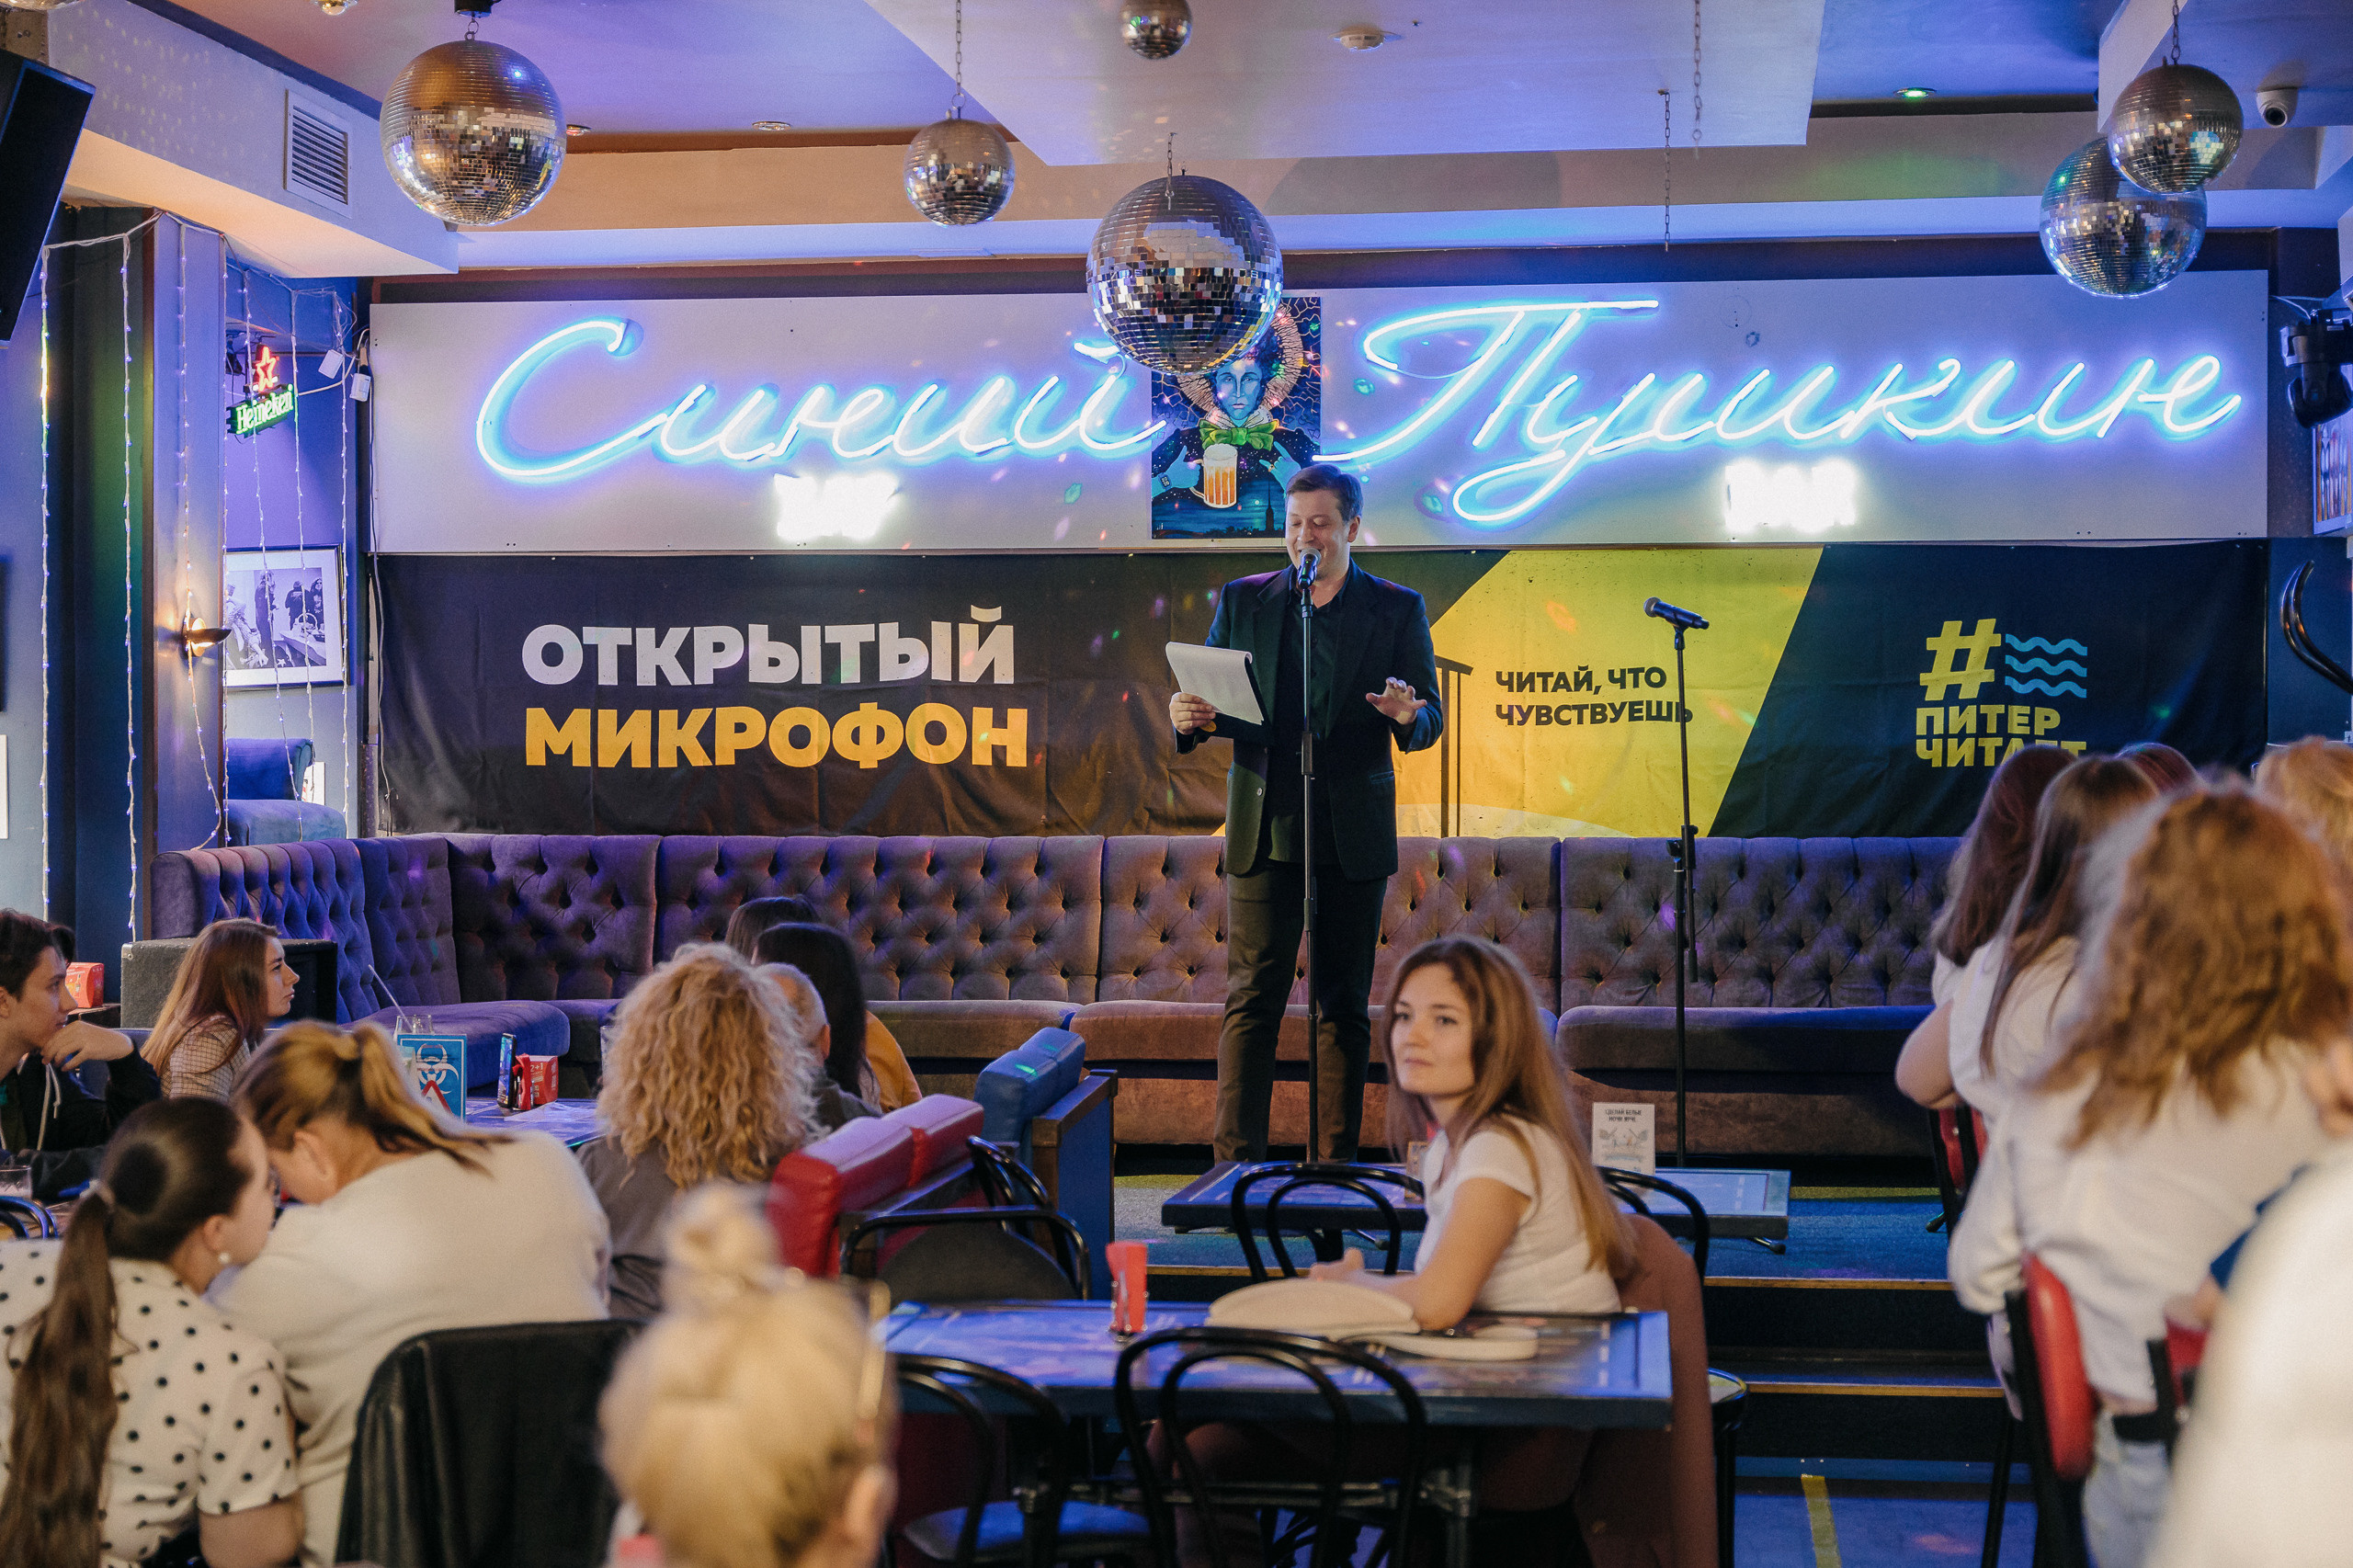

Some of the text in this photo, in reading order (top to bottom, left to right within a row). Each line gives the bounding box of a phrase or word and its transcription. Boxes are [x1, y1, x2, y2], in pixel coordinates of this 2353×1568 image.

[235, 383, 294, 435] Heineken
[473, 299, 2241, 522] Синий Пушкин
[521, 604, 1016, 687] ОТКРЫТЫЙ
[1495, 665, 1667, 696] ЧИТАЙ, ЧТО
[1495, 699, 1694, 726] ЧУВСТВУЕШЬ
[1915, 704, 2062, 736] ПИТЕР
[525, 701, 1029, 769] МИКРОФОН
[1915, 737, 2087, 767] ЧИТАТ
